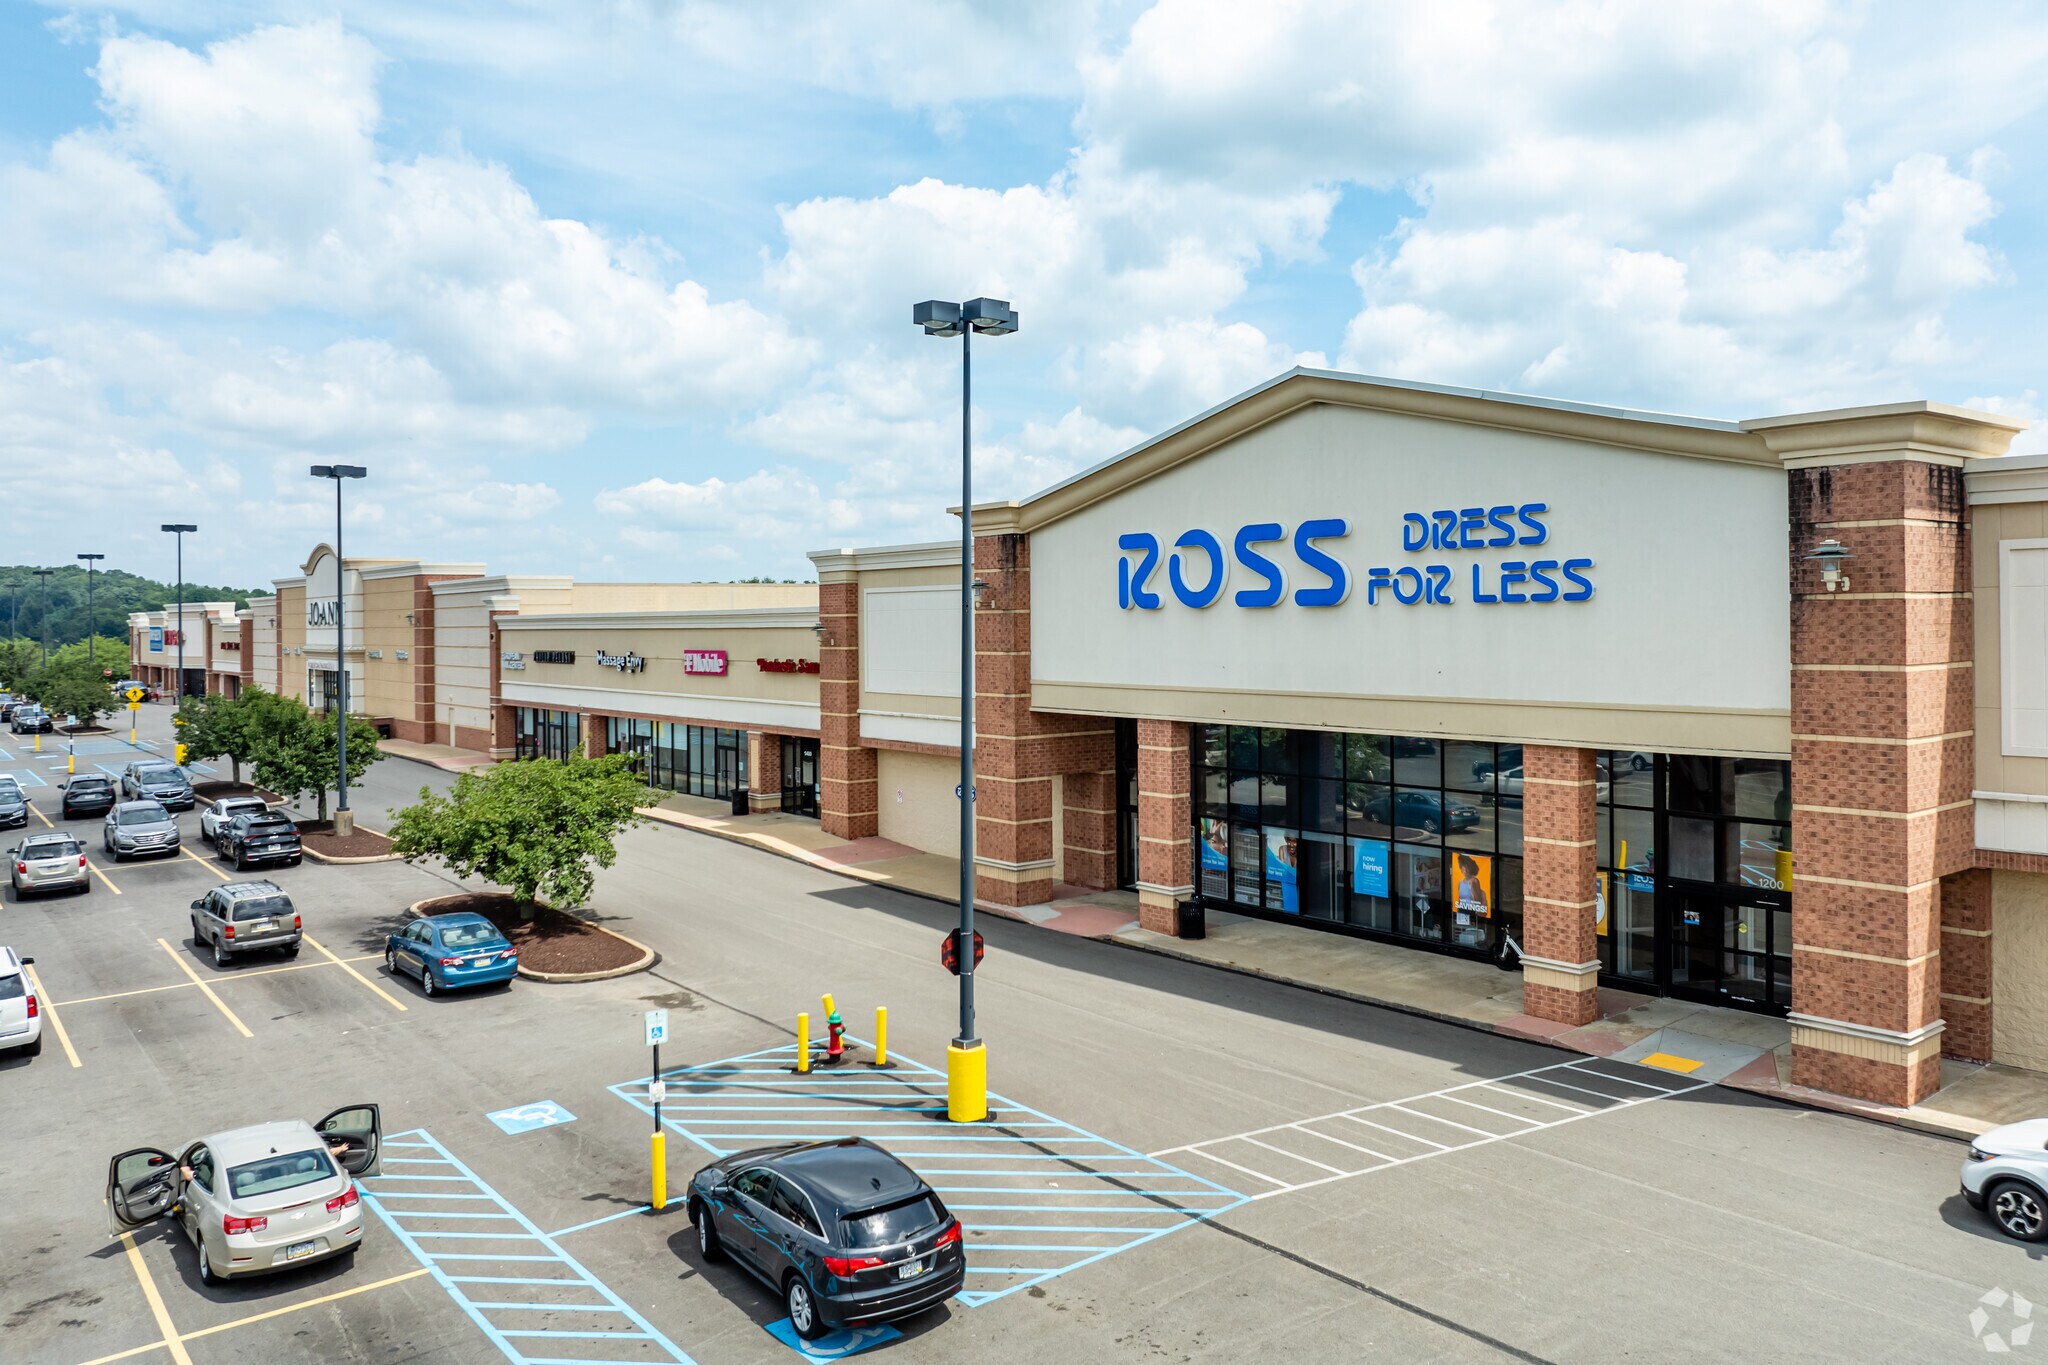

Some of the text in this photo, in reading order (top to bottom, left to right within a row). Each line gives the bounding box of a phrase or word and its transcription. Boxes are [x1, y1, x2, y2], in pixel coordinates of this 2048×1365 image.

[1403, 503, 1549, 552] DRESS
[1118, 519, 1351, 610] ROSS
[1368, 558, 1595, 606] FOR LESS
[596, 650, 625, 671] Massage
[626, 651, 644, 673] Envy
[1362, 855, 1375, 863] now
[1362, 861, 1383, 875] hiring
[1759, 878, 1784, 890] 1200
[1455, 900, 1488, 914] SAVINGS!
